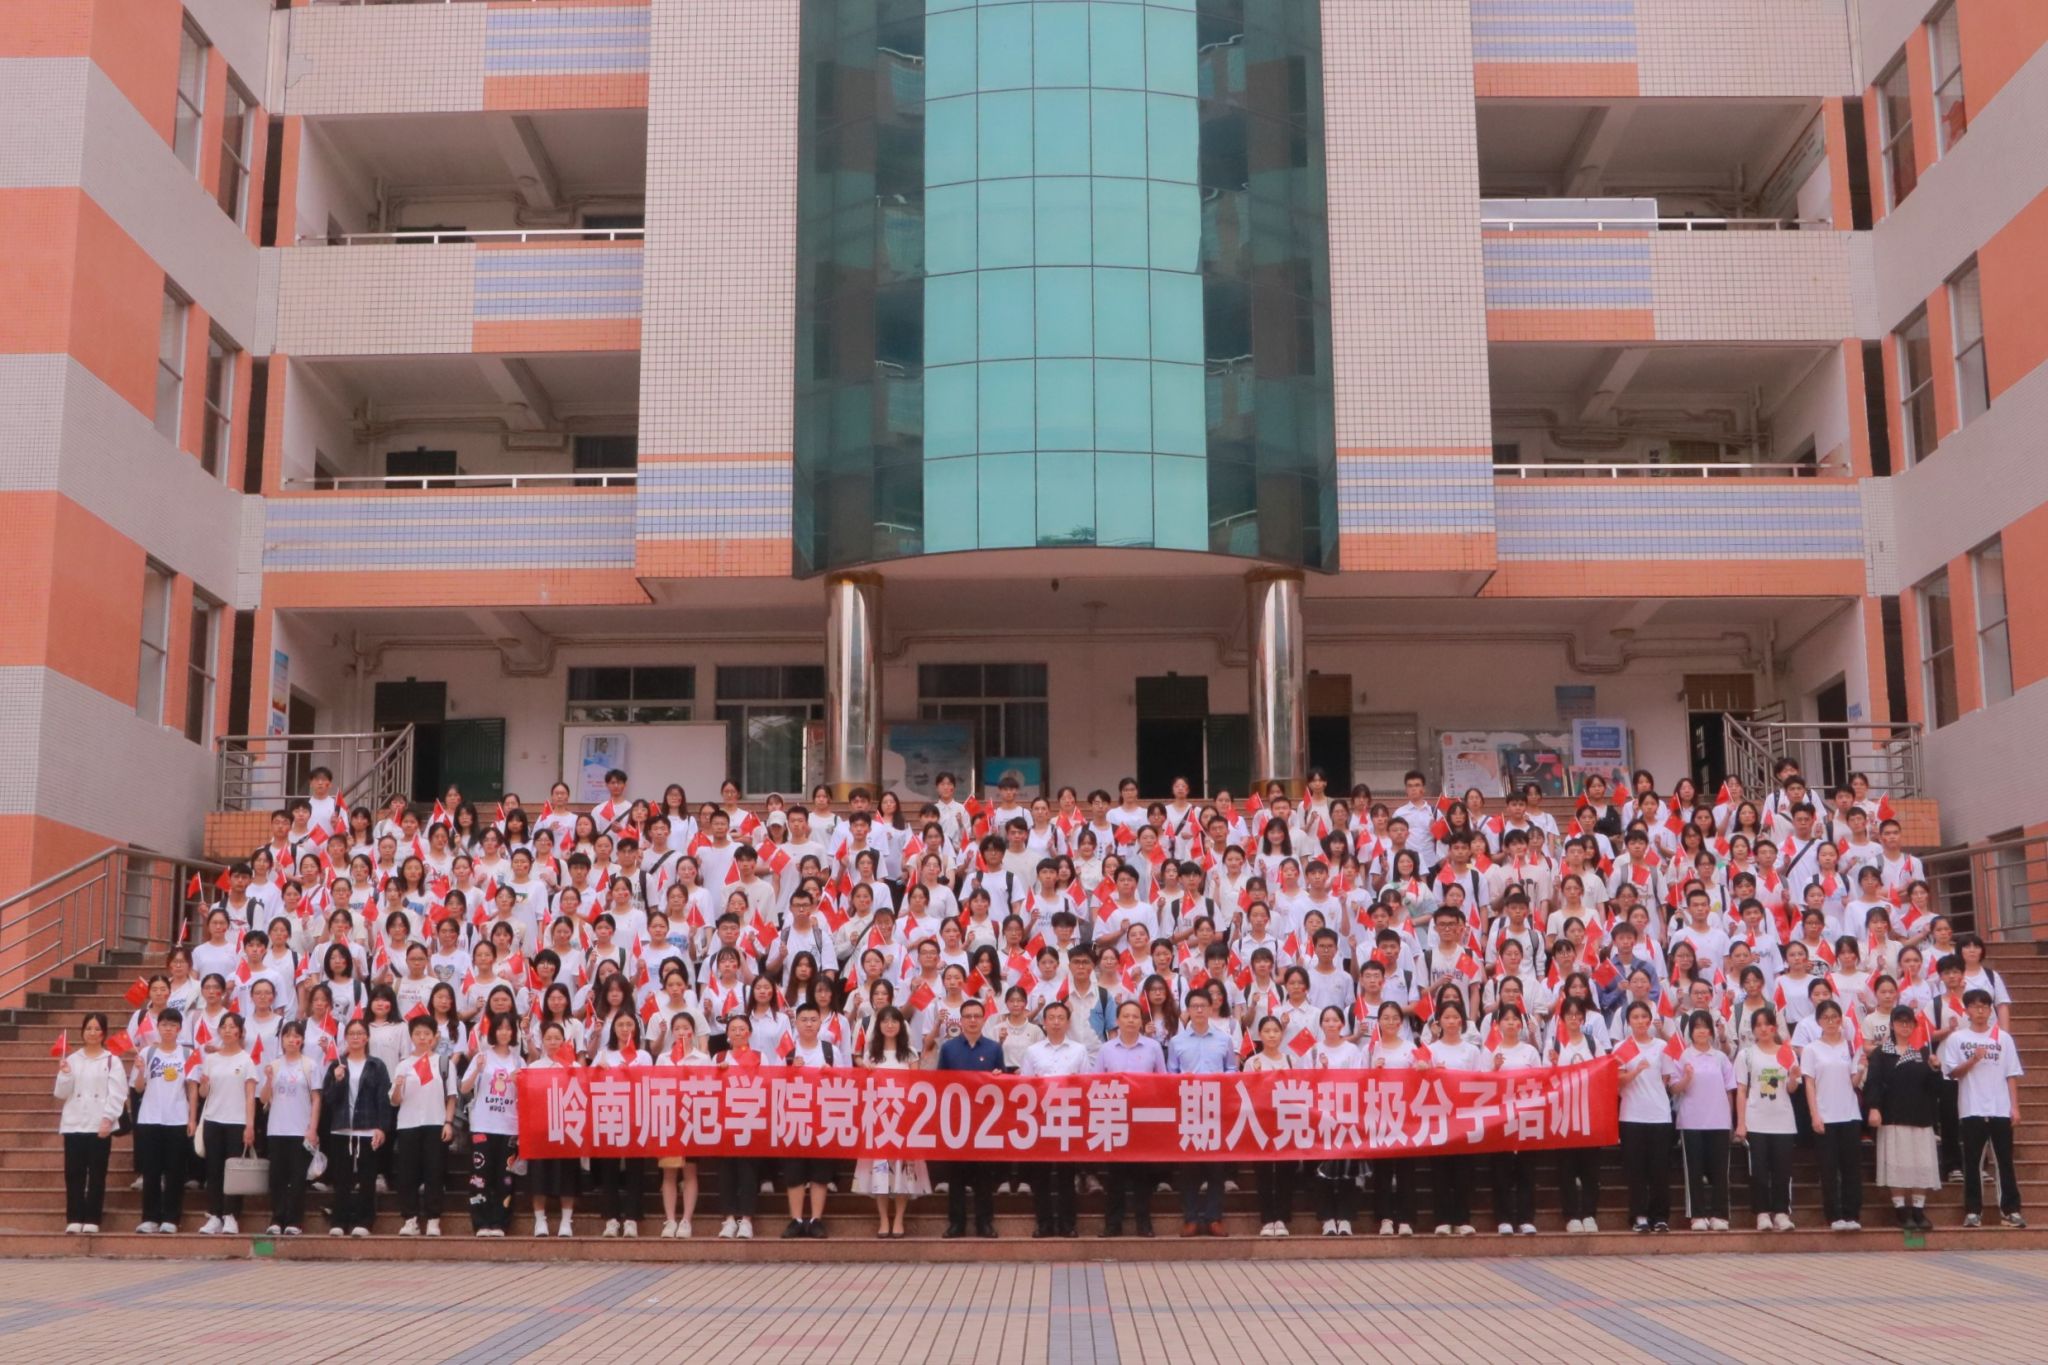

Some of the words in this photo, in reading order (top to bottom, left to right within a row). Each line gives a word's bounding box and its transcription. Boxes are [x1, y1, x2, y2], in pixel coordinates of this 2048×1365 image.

[547, 1071, 1590, 1151] 岭南师范学院党校2023年第一期入党积极分子培训
